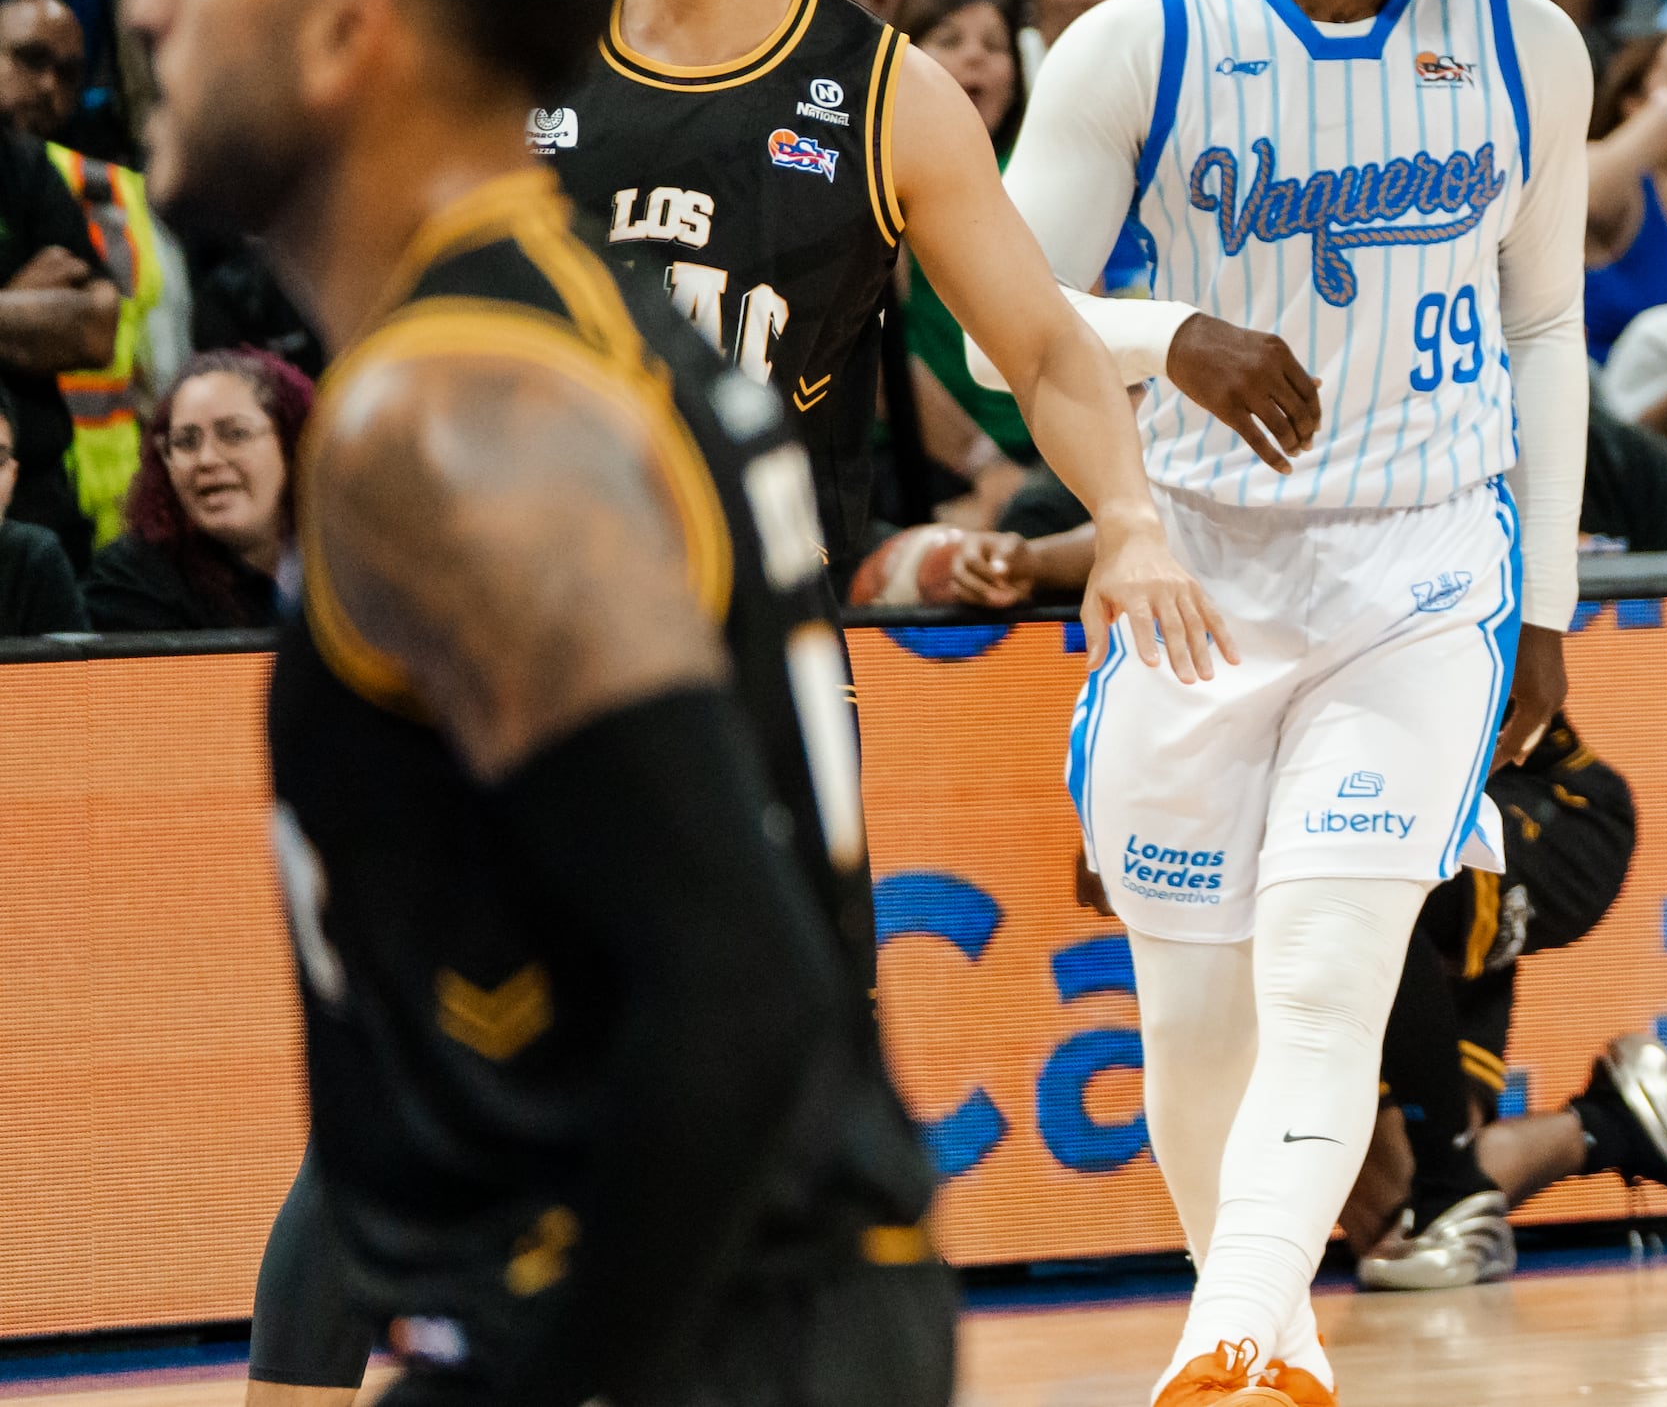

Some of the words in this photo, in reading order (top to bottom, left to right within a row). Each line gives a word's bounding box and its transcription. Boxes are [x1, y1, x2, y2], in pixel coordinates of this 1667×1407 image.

[608, 186, 715, 250] LOS
[1189, 137, 1505, 307] Vaqueros
[1410, 284, 1484, 392] 99
[1304, 808, 1417, 840] Liberty
[1126, 834, 1226, 867] Lomas
[1123, 853, 1223, 889] Verdes
[1121, 876, 1221, 905] Cooperativa
